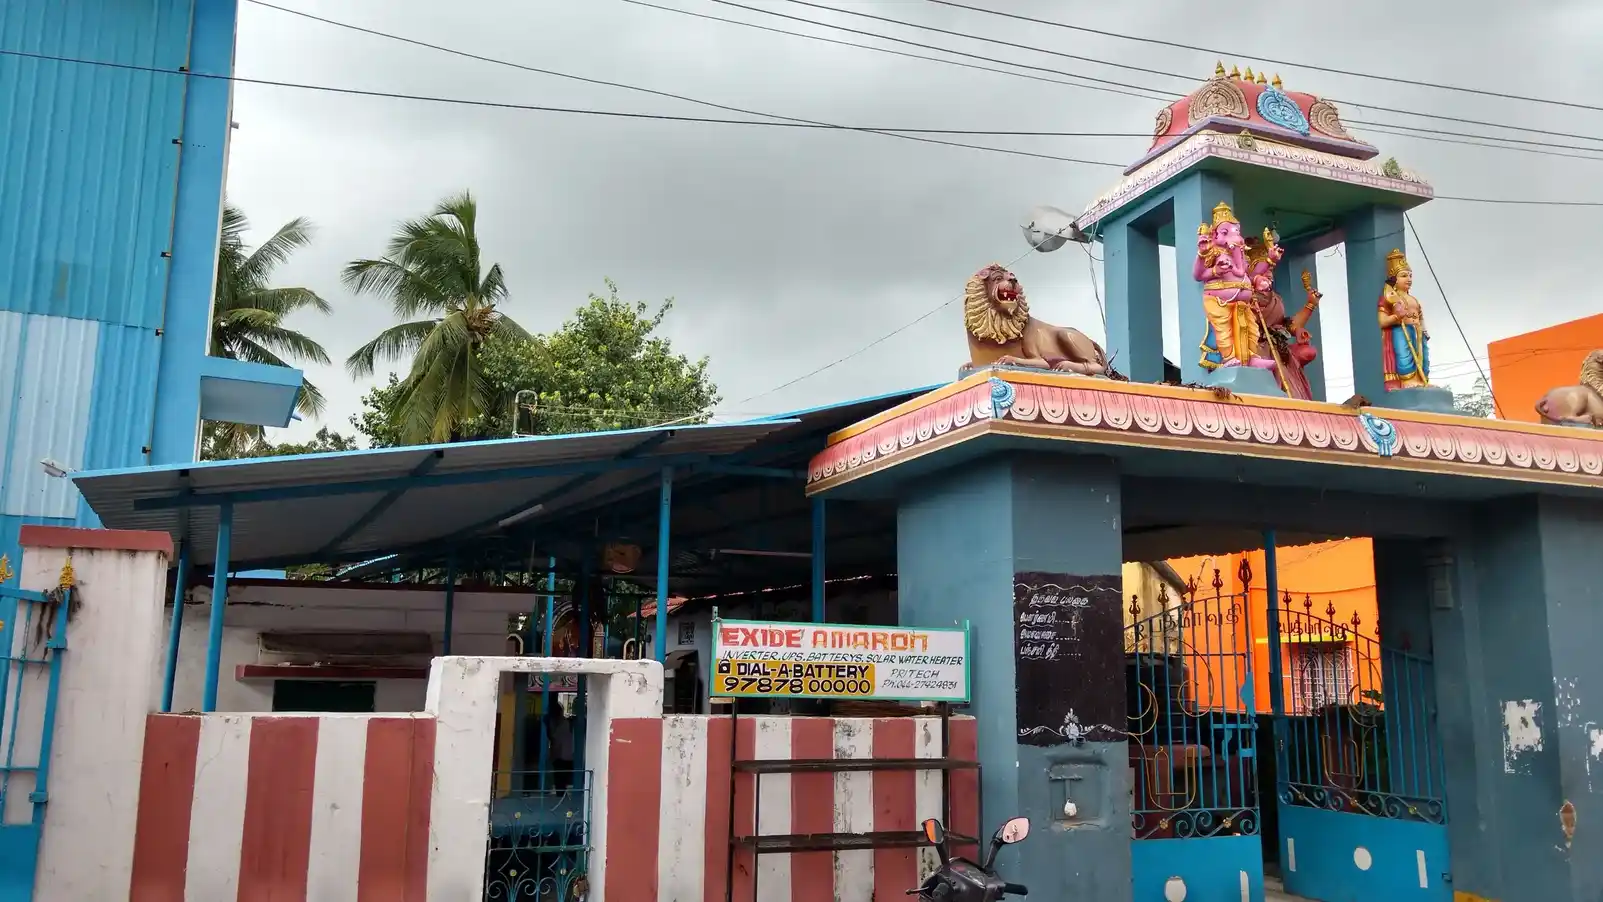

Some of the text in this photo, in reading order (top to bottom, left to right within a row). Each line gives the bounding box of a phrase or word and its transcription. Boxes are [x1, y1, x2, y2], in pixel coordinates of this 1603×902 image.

[719, 627, 928, 652] EXIDE AMARON
[898, 654, 929, 666] WATER
[930, 656, 963, 666] HEATER
[736, 662, 870, 679] DIAL-A-BATTERY
[890, 668, 940, 679] PRITECH
[724, 677, 871, 694] 97878 00000
